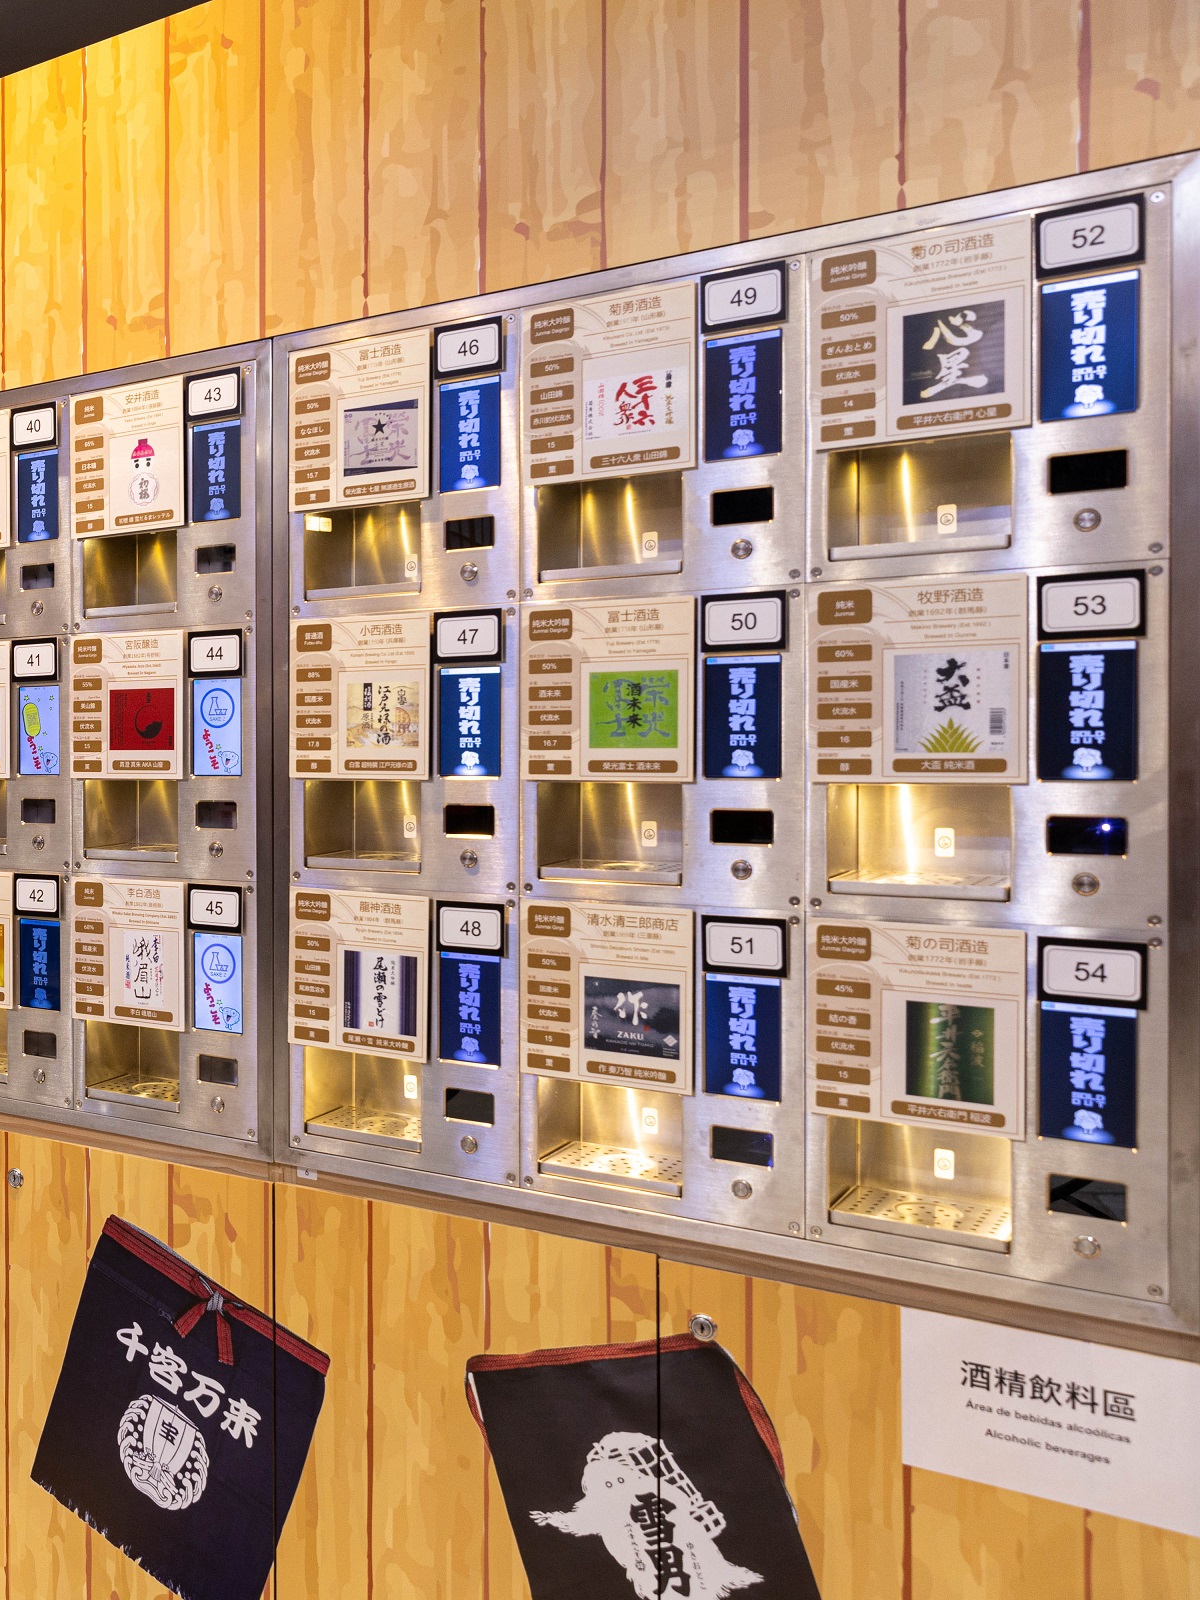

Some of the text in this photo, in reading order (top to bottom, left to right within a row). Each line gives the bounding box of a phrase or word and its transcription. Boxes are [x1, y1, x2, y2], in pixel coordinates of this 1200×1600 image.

[911, 233, 994, 260] 菊の司酒造
[1071, 226, 1105, 248] 52
[608, 296, 662, 316] 菊勇酒造
[730, 288, 756, 306] 49
[839, 312, 859, 322] 50%
[1070, 289, 1106, 365] 売り切れ
[458, 340, 478, 356] 46
[545, 363, 560, 372] 50%
[728, 344, 756, 411] 売り切れ
[124, 389, 160, 406] 安井酒造
[204, 388, 221, 402] 43
[843, 400, 853, 408] 14
[27, 419, 40, 433] 40
[458, 389, 480, 449] 売り切れ
[208, 431, 226, 484] 売り切れ
[31, 459, 46, 508] 売り切れ
[917, 587, 984, 605] 牧野酒造
[1073, 596, 1106, 615] 53
[360, 623, 403, 636] 小西酒造
[731, 613, 757, 630] 50
[457, 629, 478, 644] 47
[27, 654, 40, 666] 41
[206, 647, 223, 660] 44
[834, 650, 854, 658] 60%
[728, 667, 756, 731] 売り切れ
[1069, 654, 1105, 728] 売り切れ
[458, 677, 481, 735] 売り切れ
[626, 683, 642, 729] 酒未来
[839, 736, 849, 744] 16
[30, 889, 43, 902] 42
[206, 901, 223, 915] 45
[359, 901, 402, 915] 龍神酒造
[460, 921, 481, 936] 48
[587, 913, 679, 932] 清水清三郎商店
[32, 927, 48, 975] 売り切れ
[730, 937, 754, 954] 51
[905, 935, 989, 955] 菊の司酒造
[541, 958, 557, 966] 50%
[1074, 962, 1107, 982] 54
[373, 956, 388, 1028] 尾瀬の雪どけ
[458, 964, 481, 1022] 売り切れ
[834, 985, 854, 994] 45%
[728, 986, 757, 1052] 売り切れ
[617, 1030, 644, 1040] ZAKU
[1069, 1017, 1106, 1092] 売り切れ
[838, 1071, 848, 1079] 15
[115, 1321, 263, 1449] 千客万来
[960, 1360, 1136, 1422] 酒精飲料區
[158, 1419, 178, 1445] 宝
[997, 1407, 1011, 1417] de
[1014, 1410, 1063, 1429] bebidas
[1066, 1422, 1131, 1444] alcoólicas
[984, 1428, 1111, 1465] Alcoholic beverages
[629, 1492, 691, 1597] 雪男
